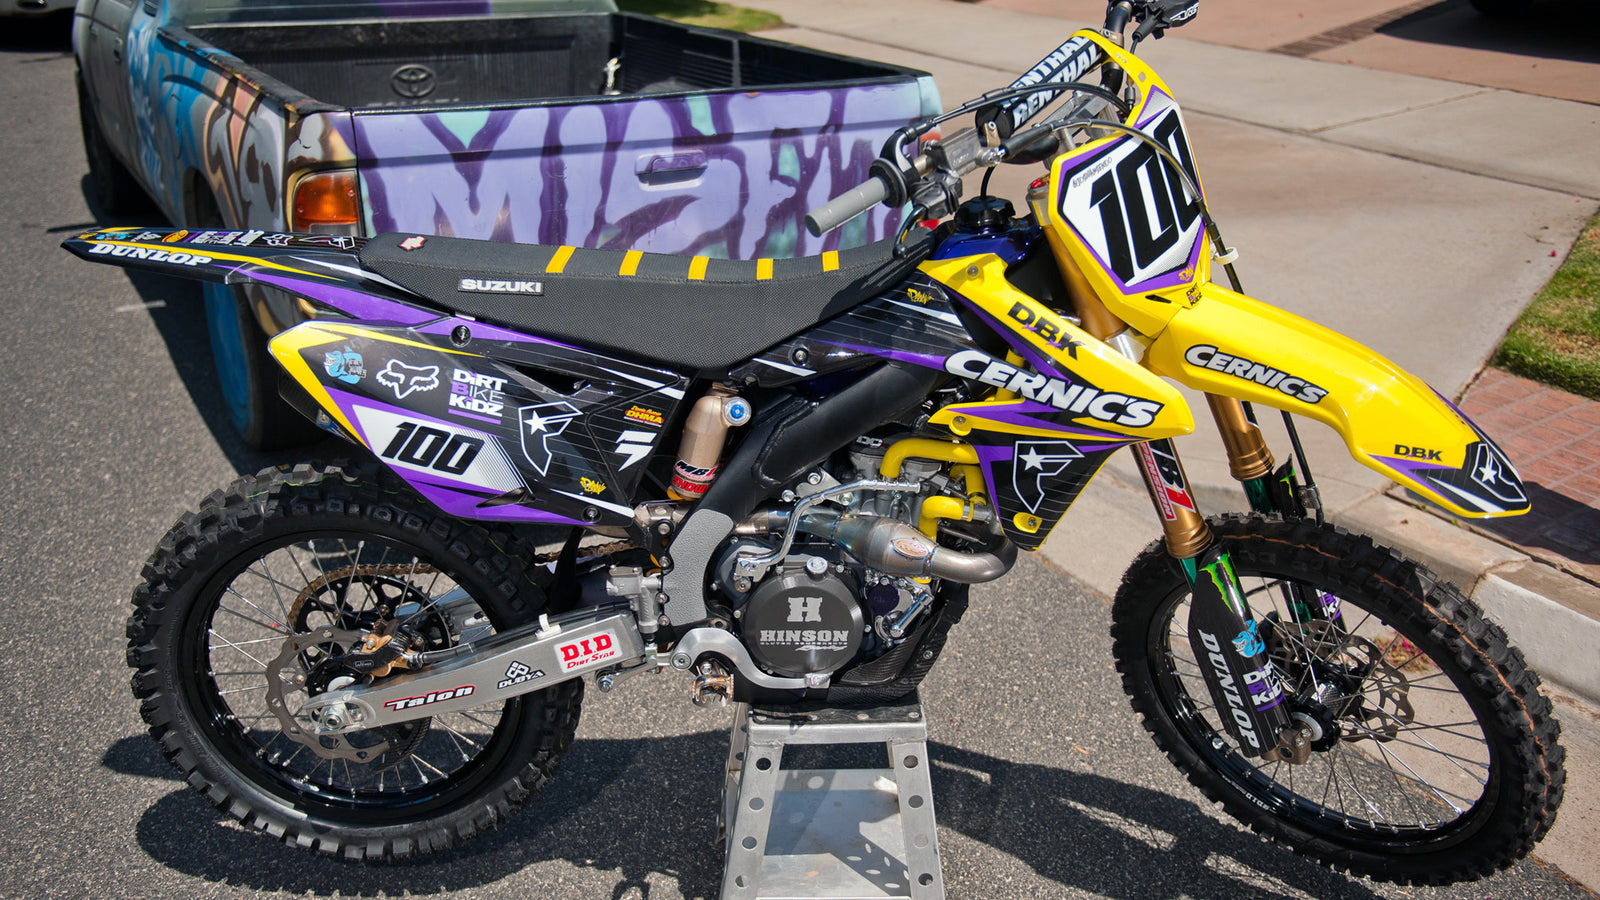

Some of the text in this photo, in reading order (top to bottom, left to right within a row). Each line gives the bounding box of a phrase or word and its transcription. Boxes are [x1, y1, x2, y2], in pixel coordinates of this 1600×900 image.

[1000, 35, 1090, 111] ENTHAL
[1089, 108, 1201, 284] 100
[88, 242, 212, 266] DUNLOP
[460, 278, 542, 293] SUZUKI
[1007, 301, 1085, 360] DBK
[451, 381, 506, 405] BIKE
[381, 421, 485, 475] 100
[1394, 444, 1442, 462] DBK
[787, 597, 822, 622] H
[760, 630, 849, 642] HINSON
[498, 670, 545, 689] DUBYA
[1198, 629, 1260, 749] DUNLOP
[386, 686, 475, 711] Talon
